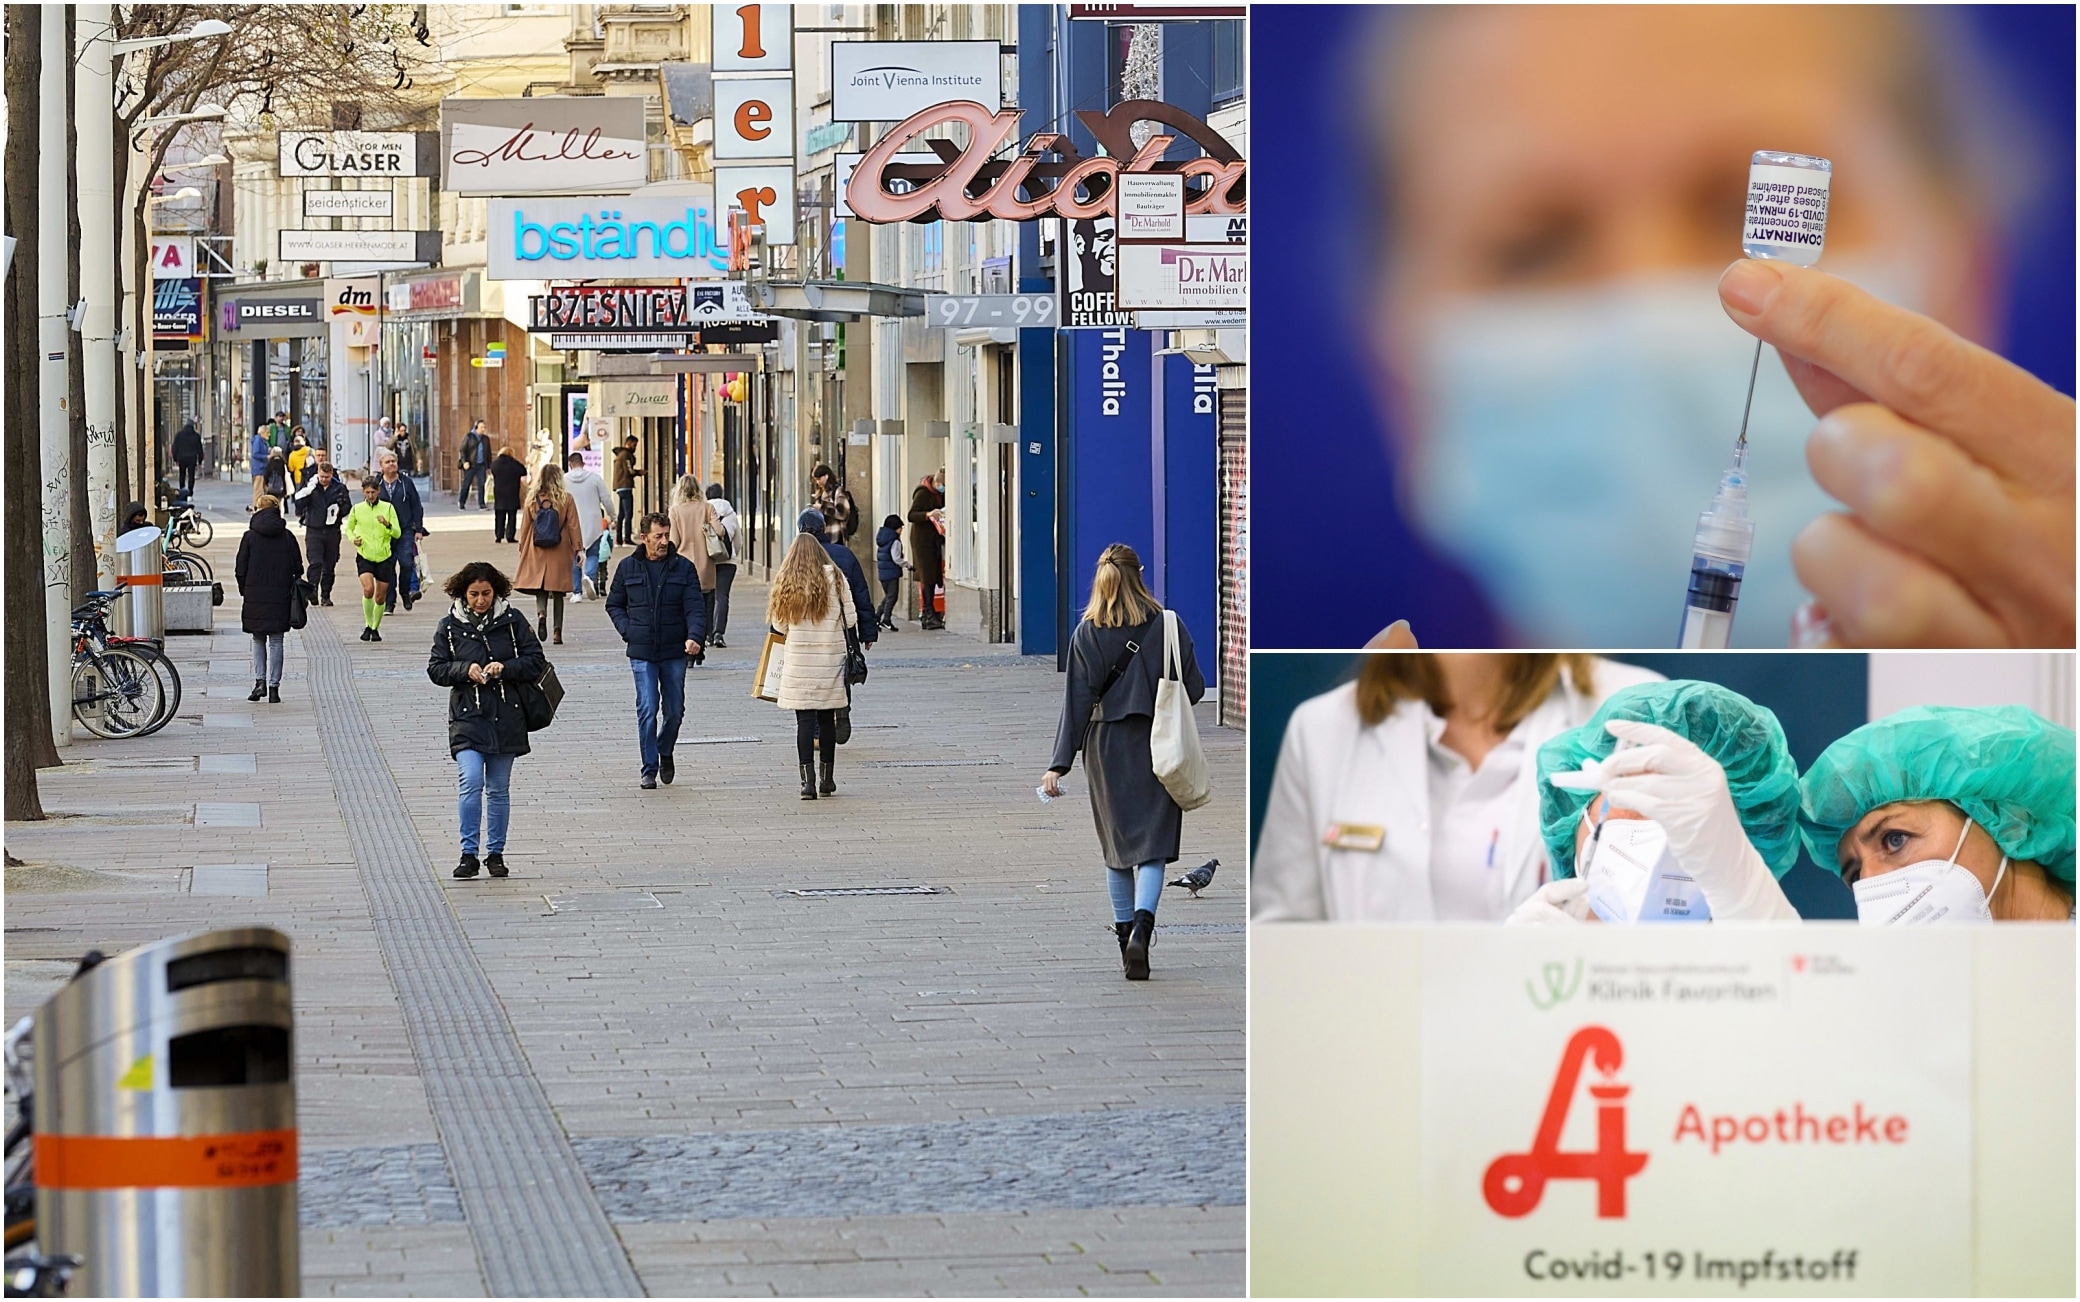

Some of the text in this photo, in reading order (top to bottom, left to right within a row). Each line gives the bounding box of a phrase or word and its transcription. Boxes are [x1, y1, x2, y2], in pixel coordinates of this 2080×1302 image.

[850, 72, 982, 90] Joint Vienna Institute
[359, 143, 402, 151] FOR MEN
[452, 121, 642, 167] Miller
[295, 137, 401, 171] GLASER
[1127, 180, 1175, 188] Hausverwaltung
[1765, 194, 1791, 206] after
[1796, 186, 1828, 200] Discard
[307, 195, 388, 209] seidensticker
[1793, 196, 1821, 210] doses
[1759, 205, 1787, 217] mRNA
[1788, 208, 1825, 222] COVID-19
[1131, 216, 1171, 228] Dr. Marhold
[1801, 221, 1824, 233] sterile
[1178, 257, 1205, 283] Dr.
[339, 286, 372, 305] dm
[1178, 283, 1238, 295] Immobilien
[241, 305, 313, 317] DIESEL
[939, 298, 979, 325] 97
[1011, 297, 1054, 324] 99
[1103, 328, 1126, 416] Thalia
[625, 390, 671, 406] Duran
[1673, 1102, 1909, 1155] Apotheke
[1523, 1249, 1860, 1289] Covid-19 Impfstoff
